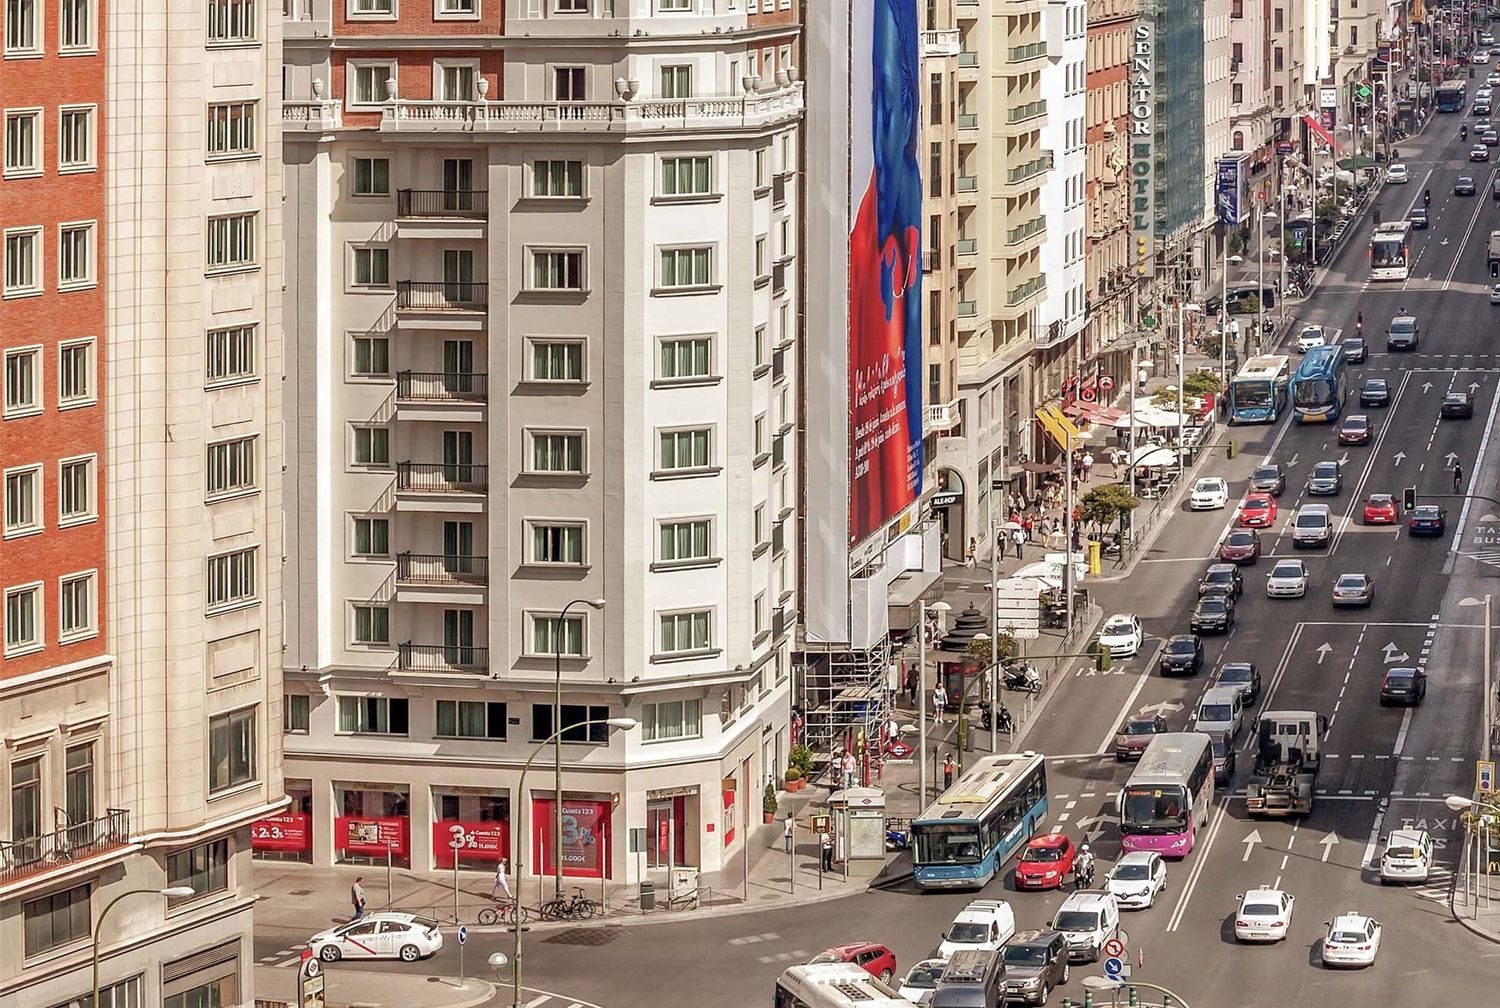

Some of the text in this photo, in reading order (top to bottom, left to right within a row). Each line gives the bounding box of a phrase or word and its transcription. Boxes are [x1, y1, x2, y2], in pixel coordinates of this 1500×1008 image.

[1133, 25, 1152, 230] SENATOR HOTEL
[933, 496, 956, 505] ALE-HOP
[1400, 818, 1457, 831] TAXI
[448, 824, 479, 850] 3%
